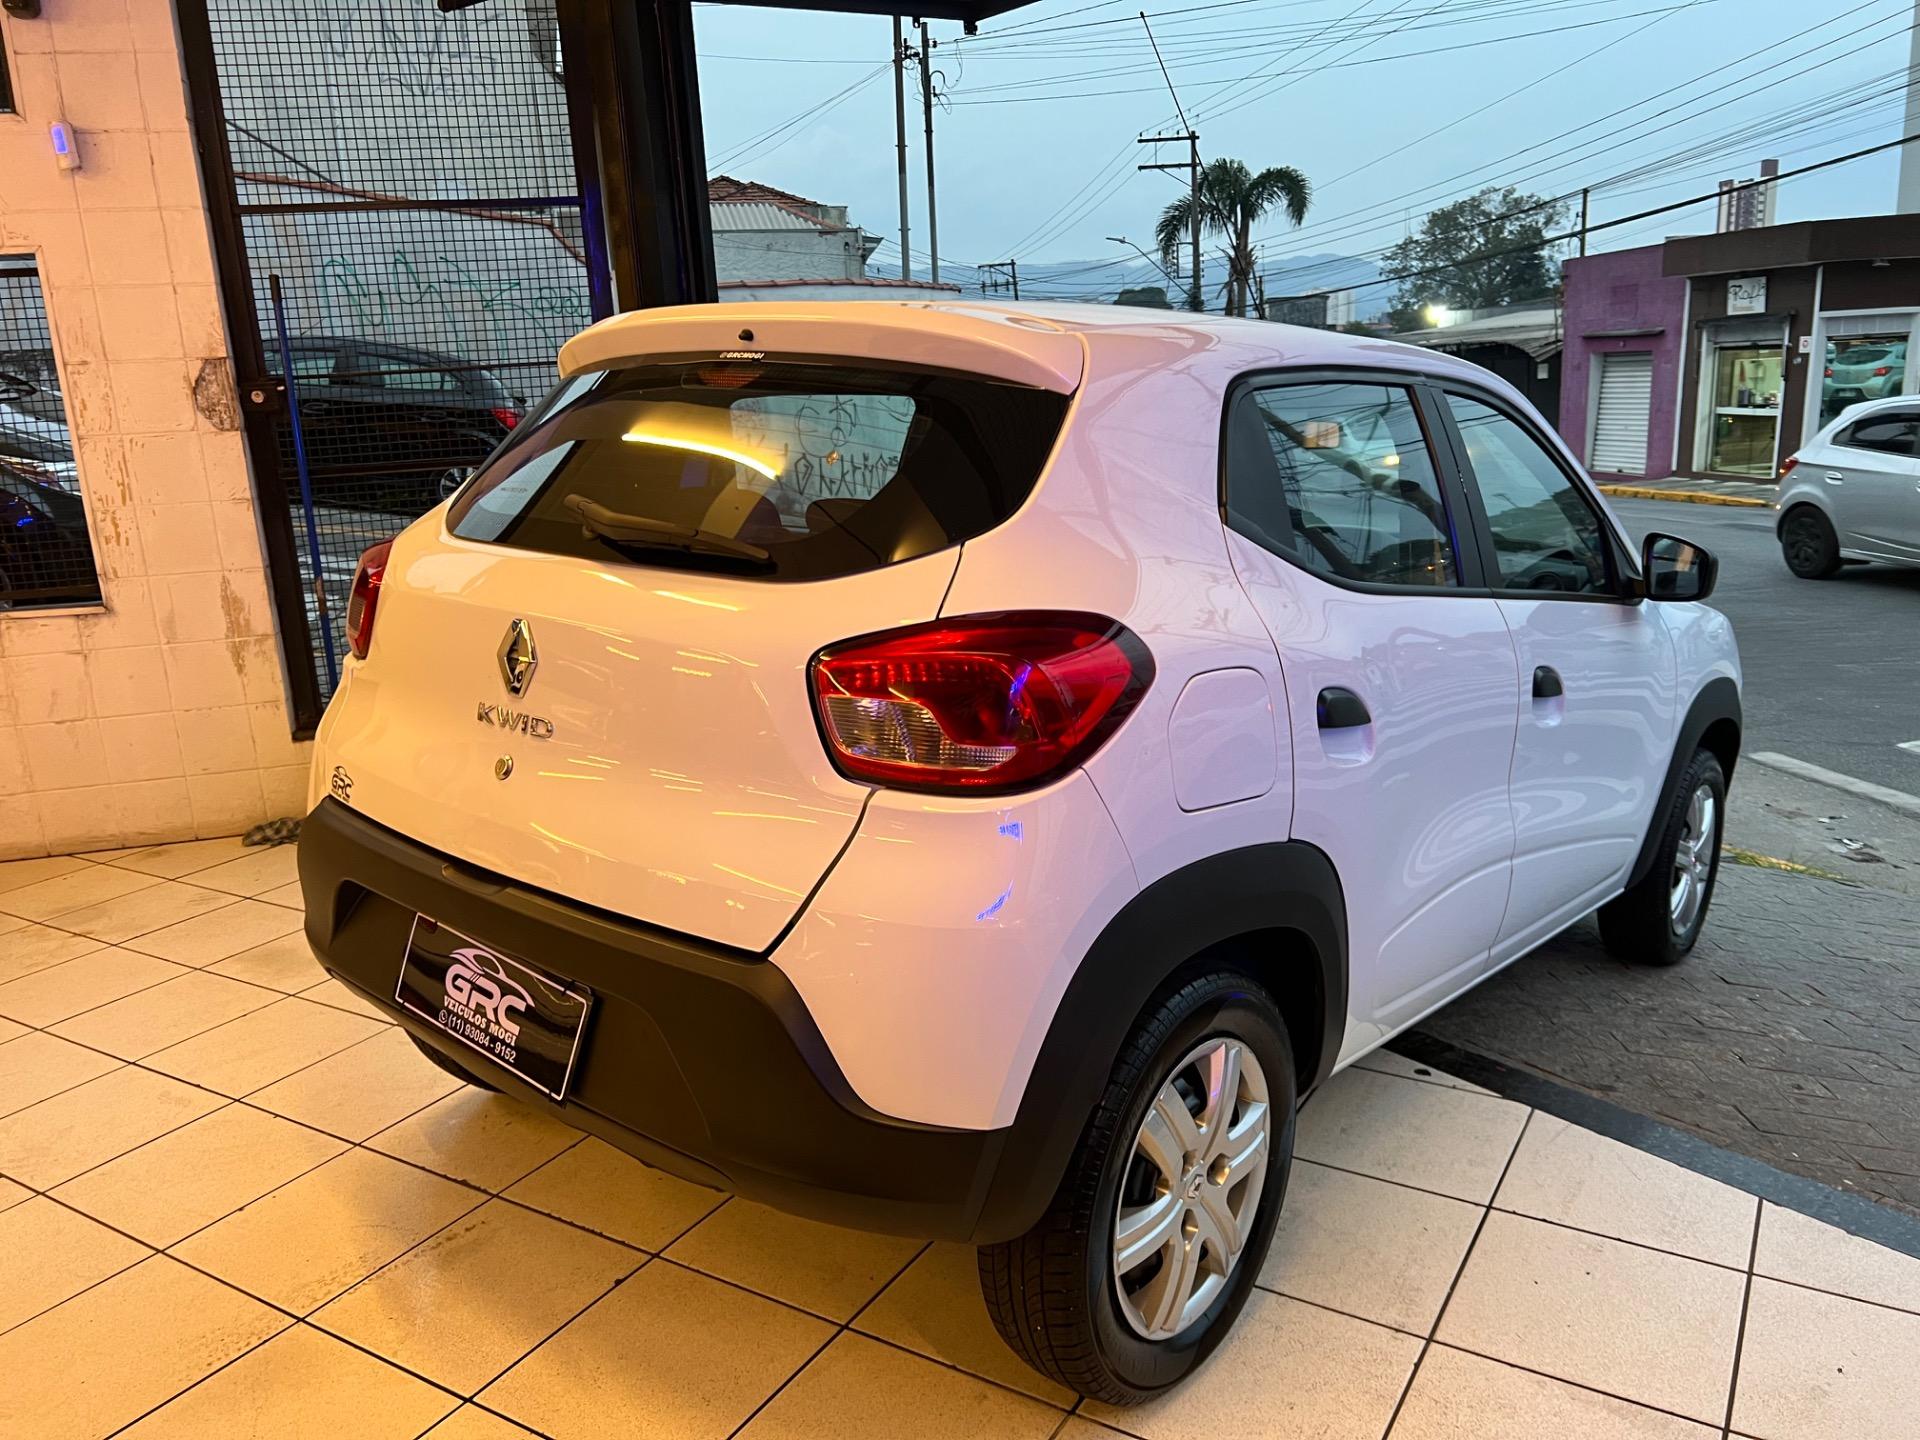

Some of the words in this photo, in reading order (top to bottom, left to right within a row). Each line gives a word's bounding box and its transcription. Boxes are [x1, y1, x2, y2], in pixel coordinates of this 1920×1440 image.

[477, 702, 553, 739] KWID
[331, 773, 352, 799] GRC
[443, 995, 487, 1029] VEICULOS
[488, 1022, 517, 1047] MOGI
[445, 963, 527, 1036] GRC
[448, 1013, 465, 1034] (11)
[464, 1023, 490, 1047] 93084
[494, 1041, 517, 1063] 9152
